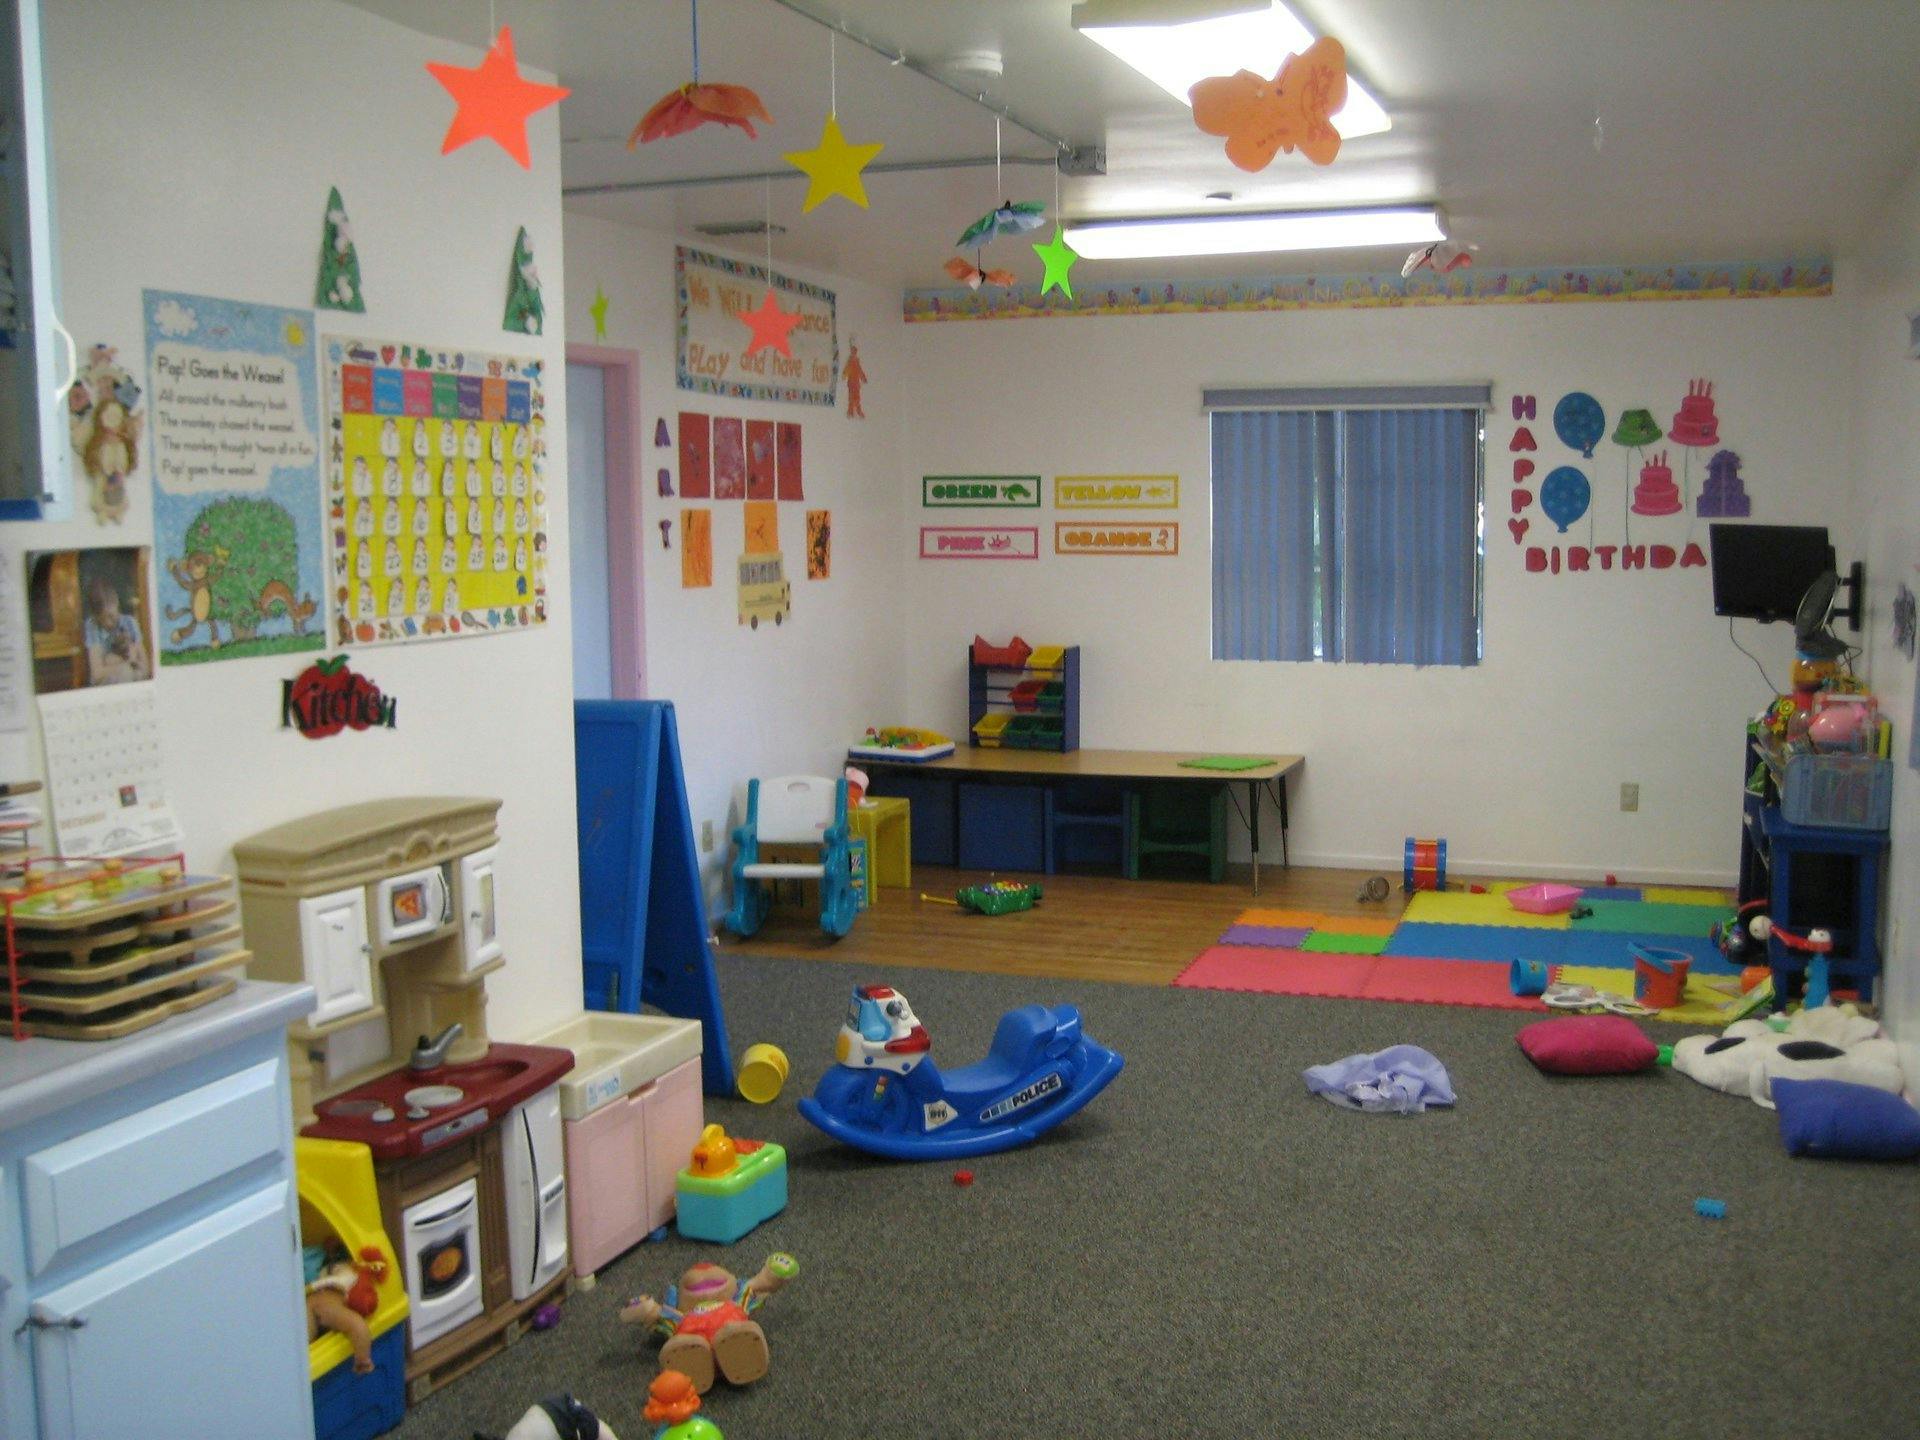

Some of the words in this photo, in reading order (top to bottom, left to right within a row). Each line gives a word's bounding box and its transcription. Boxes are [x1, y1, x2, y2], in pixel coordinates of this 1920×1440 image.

[189, 358, 219, 379] Goes
[222, 363, 239, 380] the
[242, 364, 284, 383] Weasel
[211, 394, 226, 405] the
[159, 411, 178, 426] The
[181, 416, 215, 433] monkey
[252, 418, 265, 431] the
[161, 435, 180, 449] The
[183, 439, 218, 456] monkey
[220, 440, 253, 458] thought
[211, 464, 225, 475] the
[1508, 395, 1537, 545] HAPPY
[932, 484, 997, 499] GREEN
[1062, 484, 1141, 499] YELLOW
[938, 535, 985, 550] PINK
[1064, 531, 1151, 547] ORANGE
[282, 675, 396, 731] Kitchen
[1012, 1073, 1059, 1107] POLICE
